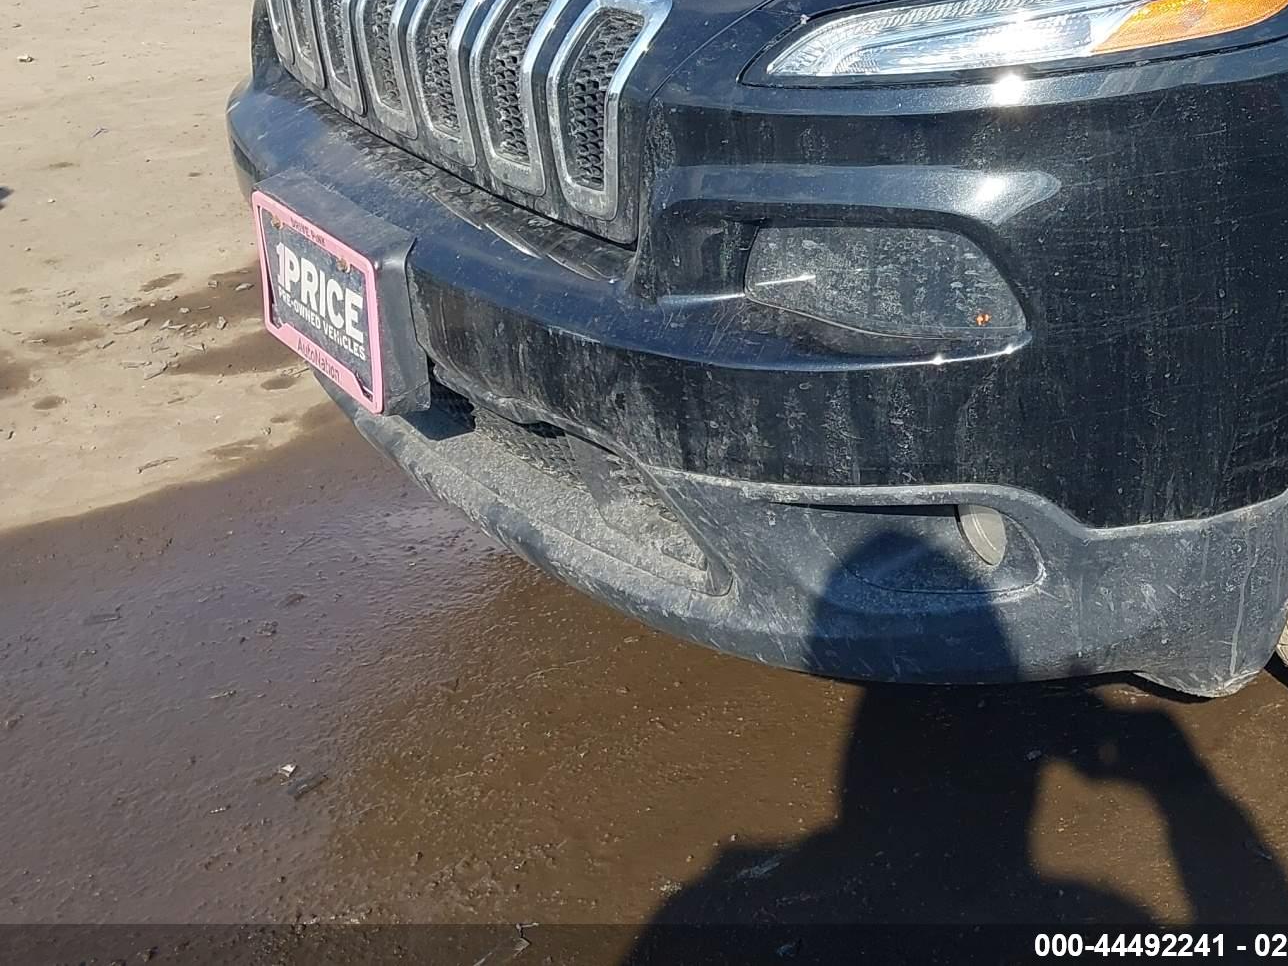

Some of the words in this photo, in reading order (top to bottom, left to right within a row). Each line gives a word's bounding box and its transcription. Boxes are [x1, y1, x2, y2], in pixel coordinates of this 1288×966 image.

[278, 285, 321, 330] PRE-OWNED
[323, 320, 366, 361] VEHICLES
[297, 337, 340, 382] AutoNation
